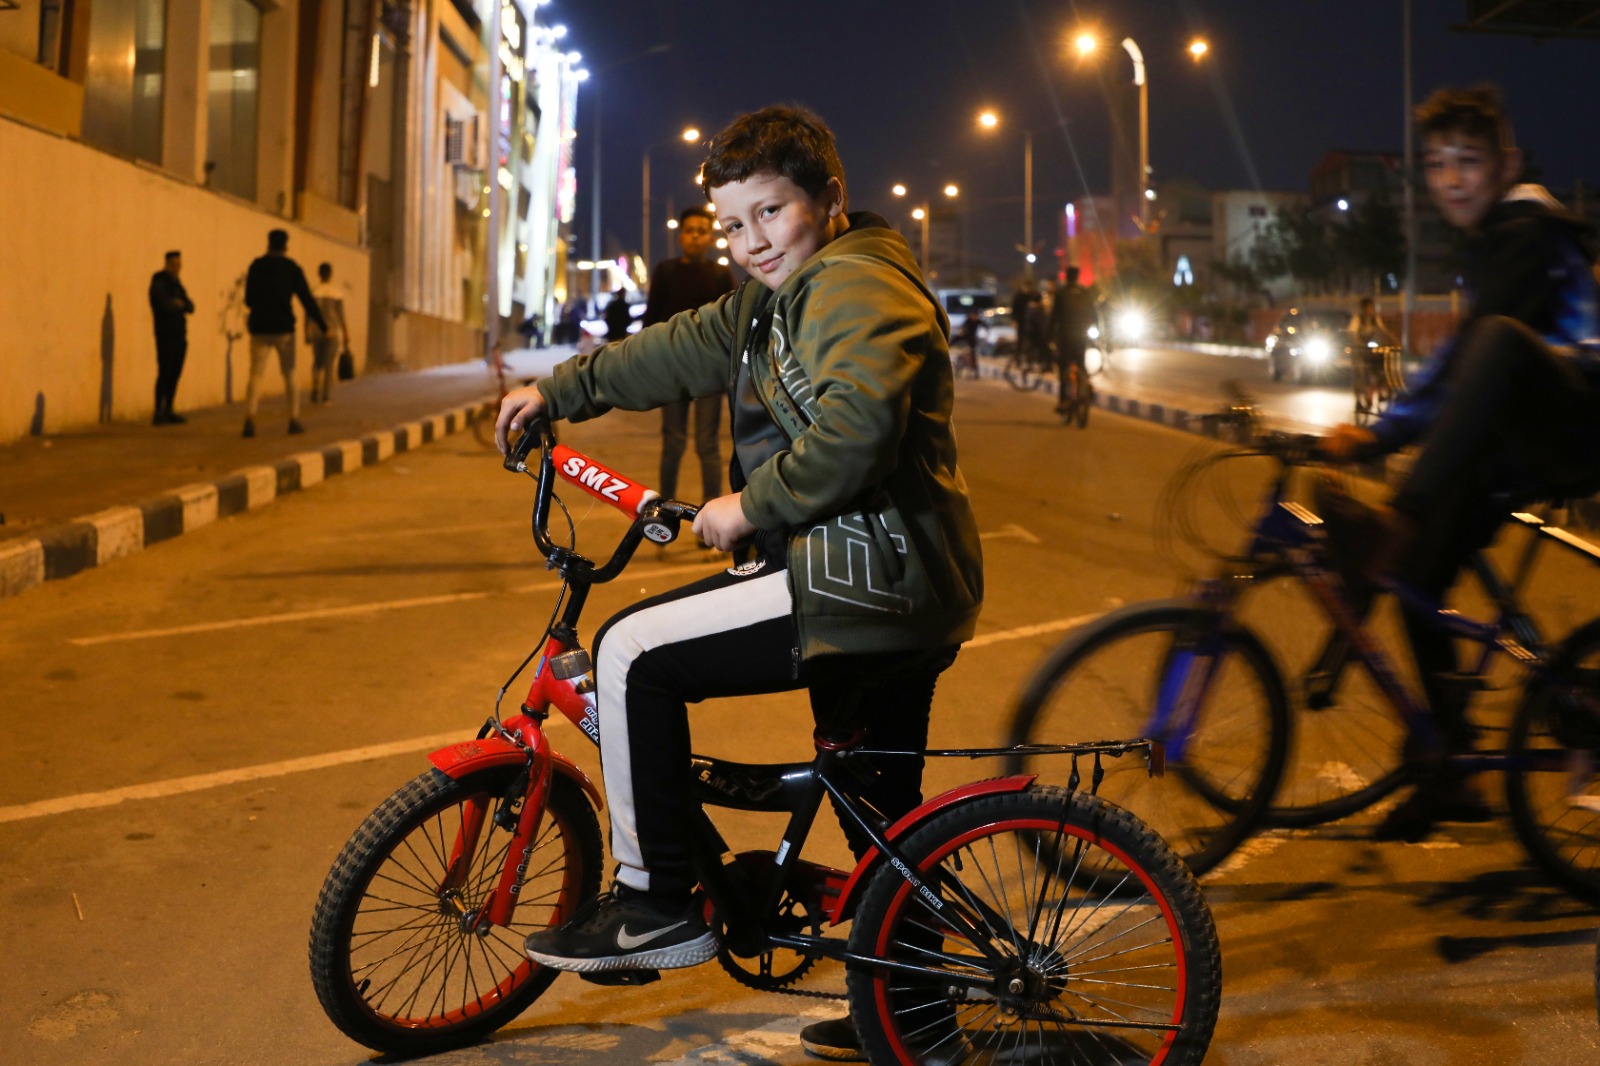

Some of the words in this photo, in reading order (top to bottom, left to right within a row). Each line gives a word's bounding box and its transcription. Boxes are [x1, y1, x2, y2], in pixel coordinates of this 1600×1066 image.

[562, 457, 630, 502] SMZ
[580, 717, 600, 744] 202
[920, 885, 944, 910] BIKE
